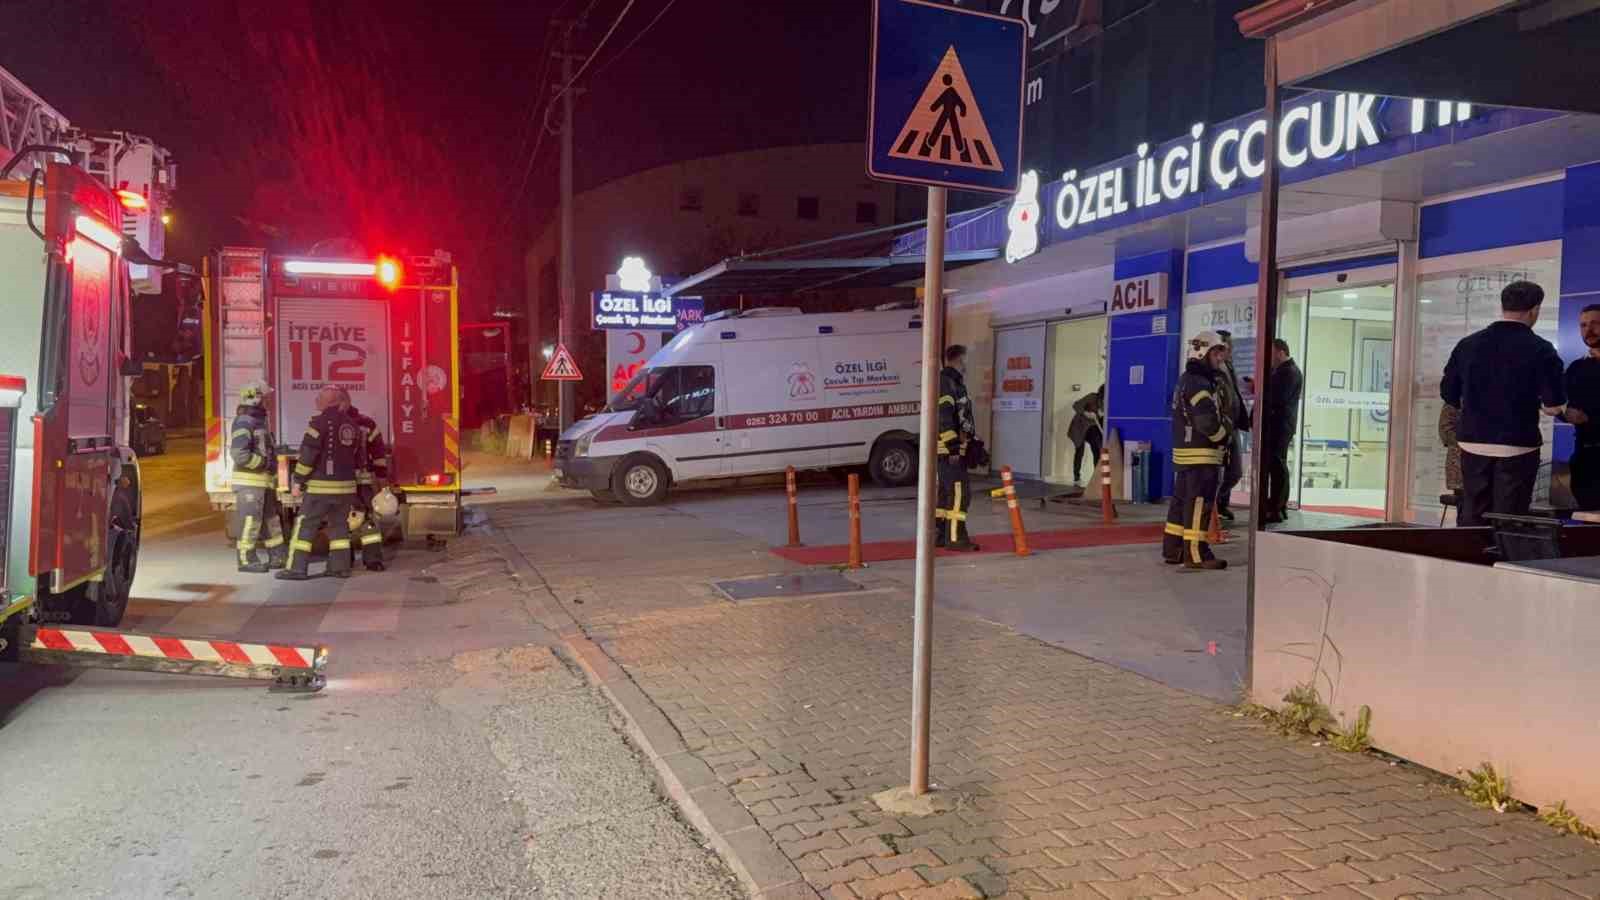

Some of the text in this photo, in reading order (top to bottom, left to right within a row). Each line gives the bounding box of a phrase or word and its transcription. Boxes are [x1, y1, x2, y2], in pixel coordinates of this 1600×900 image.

[1056, 169, 1128, 229] ÖZEL
[1135, 121, 1203, 208] İLGİ
[1210, 93, 1380, 190] ÇOCUK
[600, 293, 672, 312] ÖZEL İLGİ
[1111, 279, 1154, 312] ACİL
[289, 321, 367, 341] İTFAİYE
[289, 341, 367, 381] 112
[835, 357, 887, 374] ÖZEL İLGİ
[400, 317, 415, 433] İTFAİYE
[768, 413, 787, 425] 324
[790, 412, 803, 422] 70
[805, 411, 819, 422] 00
